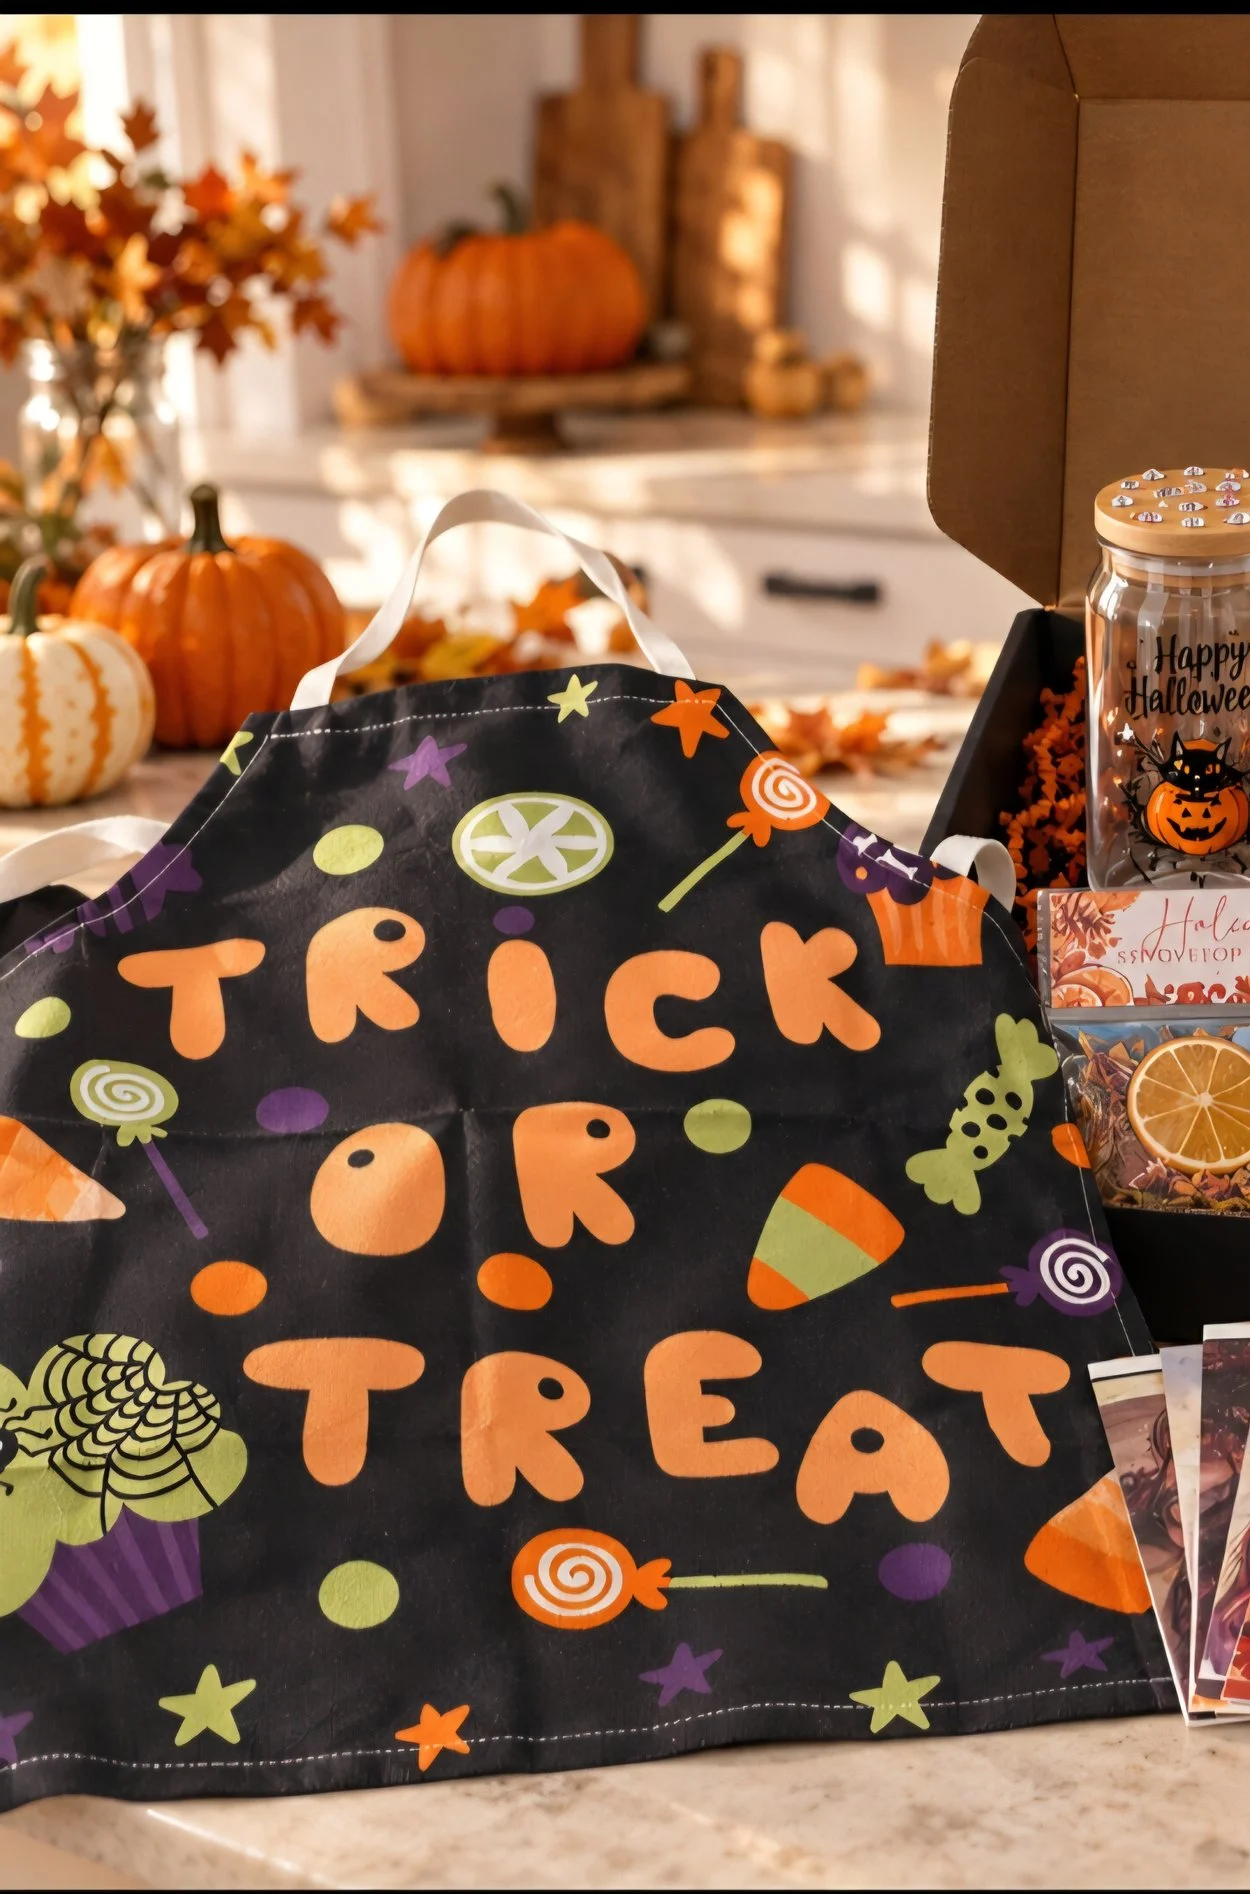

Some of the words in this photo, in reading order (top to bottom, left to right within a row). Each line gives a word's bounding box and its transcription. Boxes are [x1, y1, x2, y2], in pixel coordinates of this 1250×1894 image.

[118, 906, 882, 1072] TRICK
[310, 1100, 636, 1256] OR
[243, 1329, 1071, 1525] TREAT
